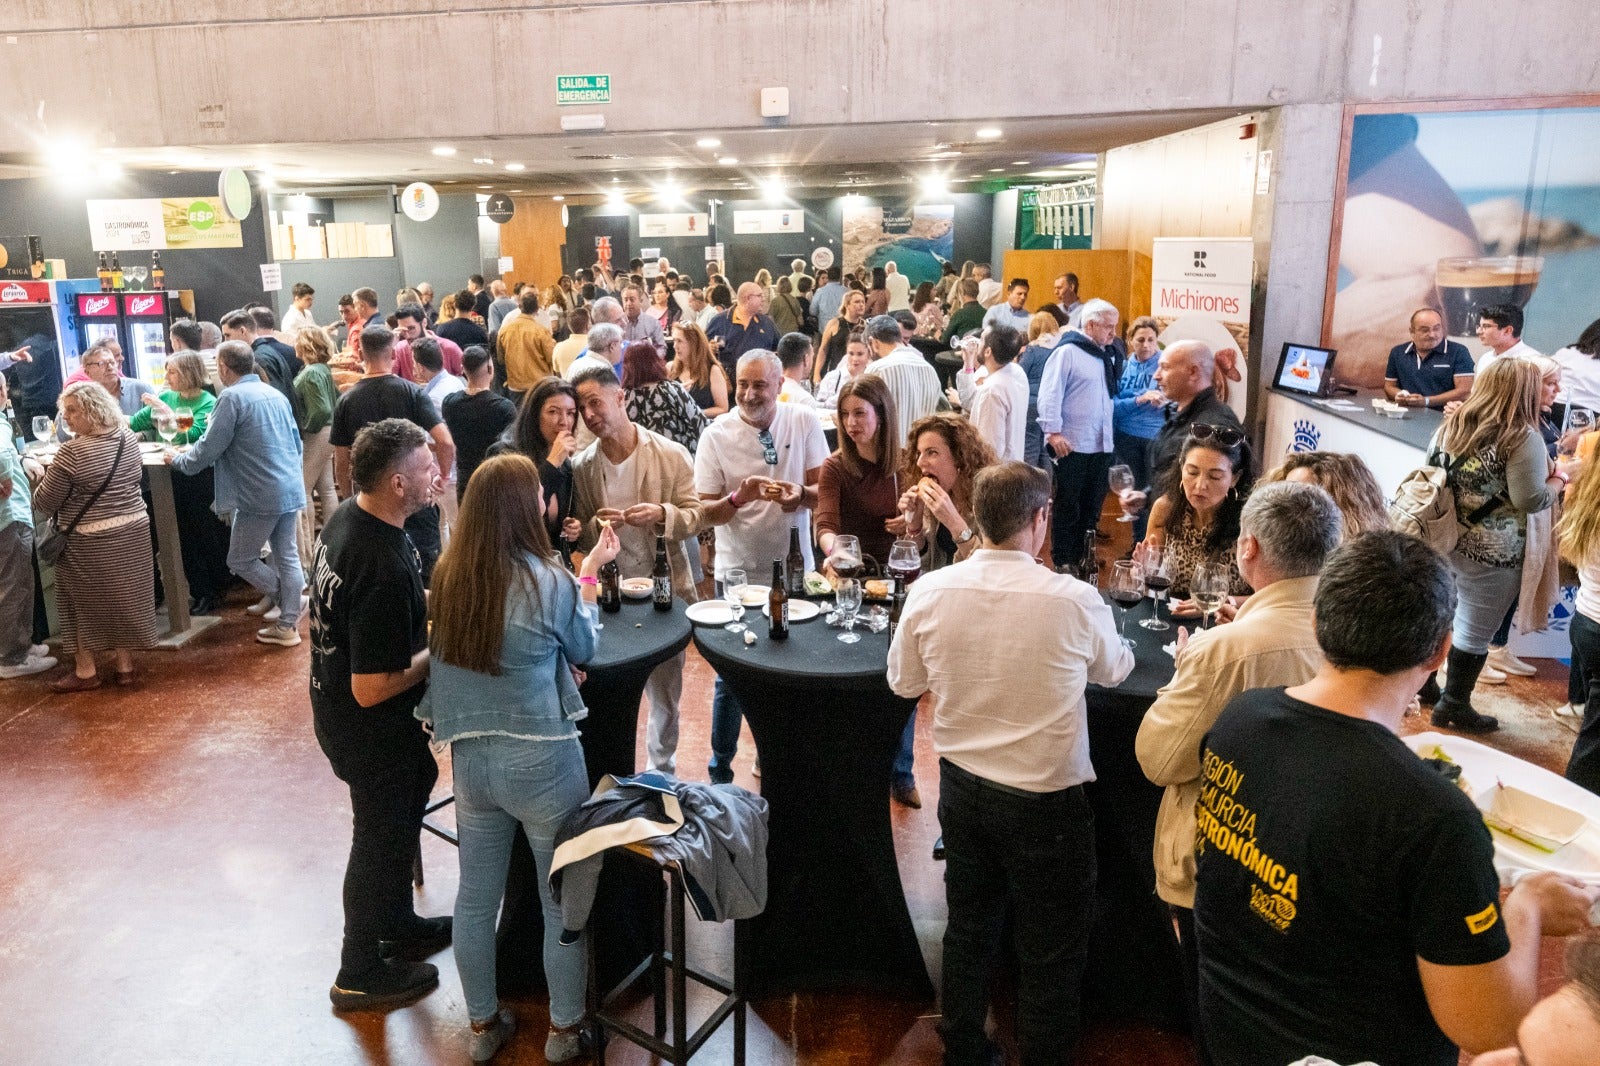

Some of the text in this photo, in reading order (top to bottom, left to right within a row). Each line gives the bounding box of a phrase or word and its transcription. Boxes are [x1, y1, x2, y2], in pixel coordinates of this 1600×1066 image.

[560, 77, 607, 89] SALIDA DE
[559, 90, 609, 101] EMERGENCIA
[189, 210, 214, 223] ESP
[1160, 287, 1240, 315] Michirones
